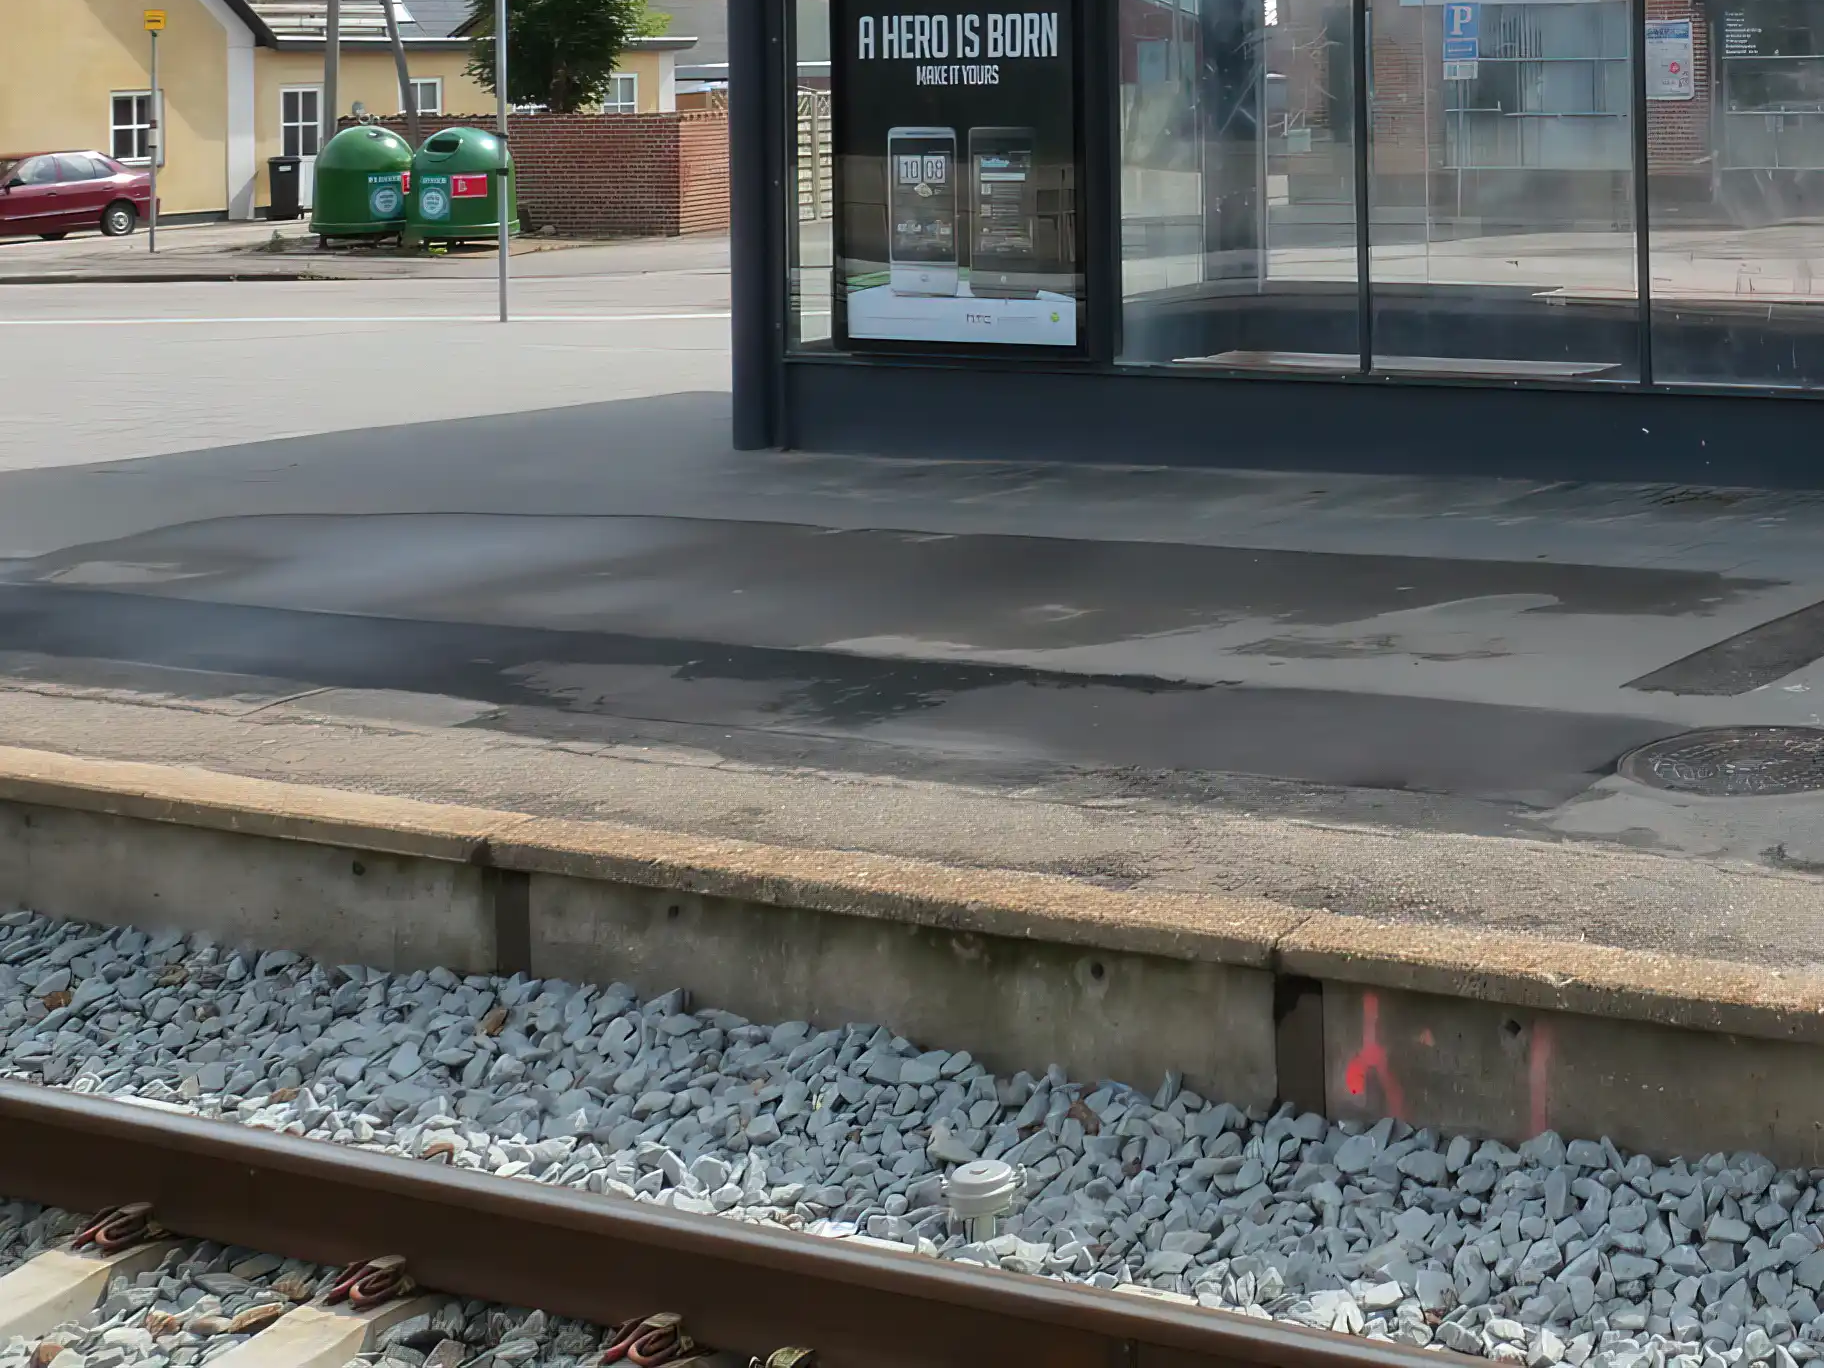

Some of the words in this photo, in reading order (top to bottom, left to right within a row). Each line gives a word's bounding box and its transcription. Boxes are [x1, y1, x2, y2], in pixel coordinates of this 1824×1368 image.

[1450, 5, 1472, 36] P
[858, 15, 875, 60] A
[882, 14, 949, 60] HERO
[956, 13, 980, 59] IS
[987, 12, 1058, 58] BORN
[916, 65, 948, 86] MAKE
[949, 65, 960, 85] IT
[961, 64, 1000, 85] YOURS
[903, 160, 919, 179] 10
[926, 159, 944, 179] 08
[966, 313, 991, 325] htc
